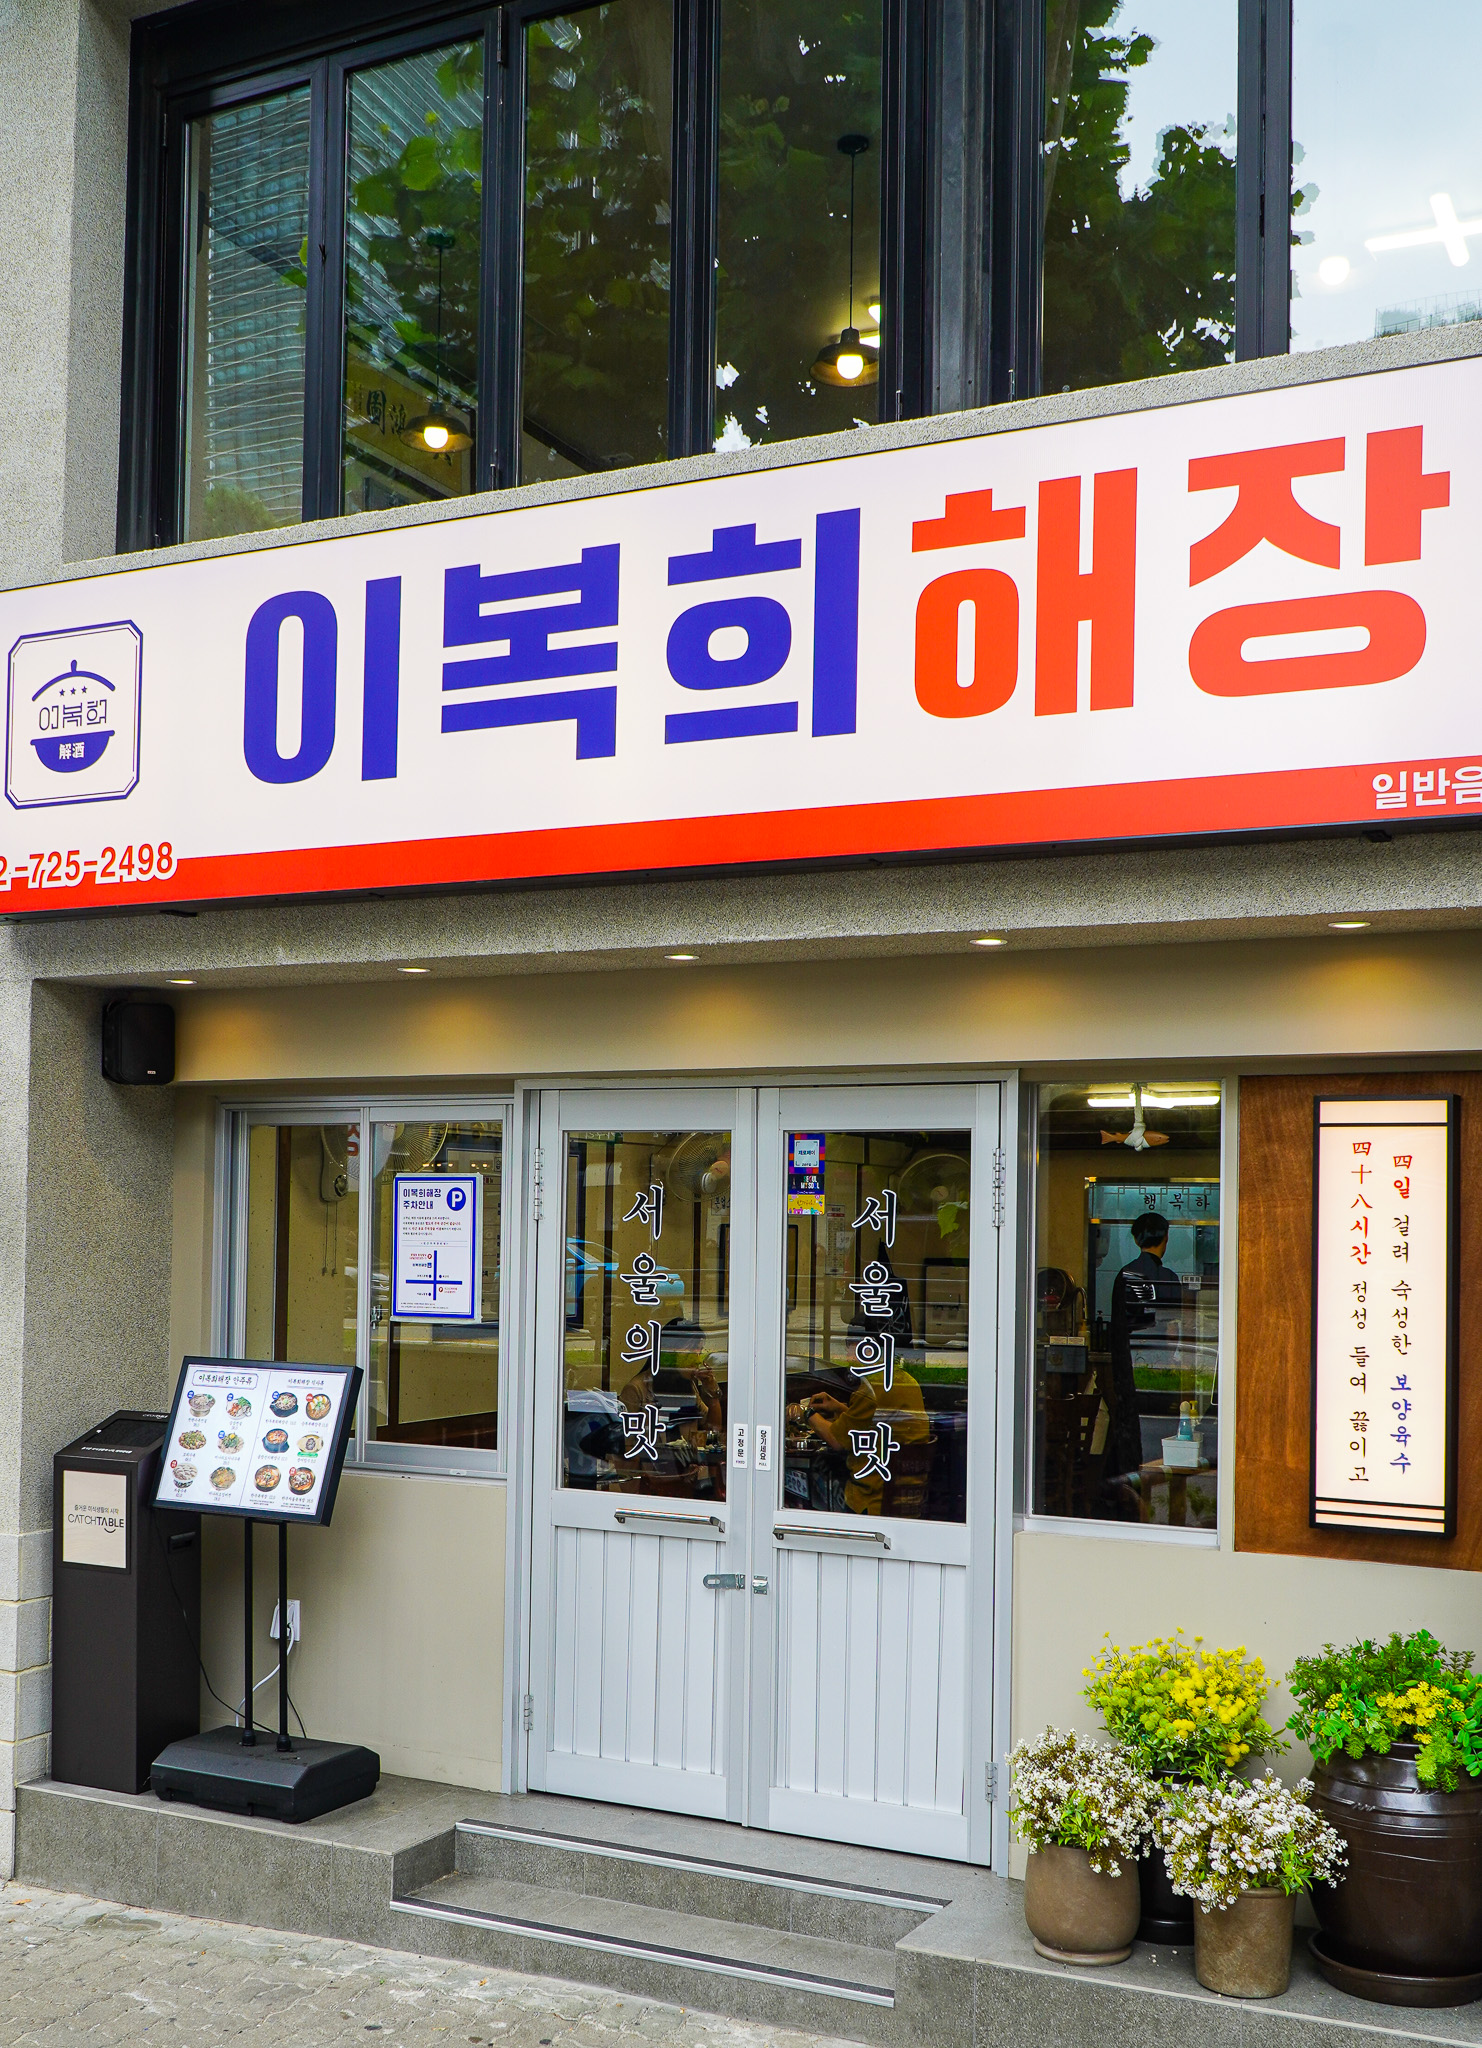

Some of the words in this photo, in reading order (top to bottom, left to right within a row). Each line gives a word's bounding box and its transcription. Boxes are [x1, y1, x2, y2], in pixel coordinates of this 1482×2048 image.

[243, 425, 1450, 785] 이복희해장
[38, 699, 108, 731] 이복희
[59, 742, 85, 760] 解酒
[402, 1188, 441, 1198] 이복희해장
[451, 1190, 463, 1208] P
[1393, 1154, 1413, 1199] 四일
[403, 1201, 434, 1210] 주차안내
[1392, 1214, 1409, 1264] 걸려
[619, 1185, 669, 1376] 서울의
[848, 1189, 903, 1392] 서울의
[1351, 1280, 1367, 1329] 정성
[1391, 1280, 1412, 1355] 숙성한
[1349, 1346, 1370, 1394] 들여
[618, 1404, 666, 1461] 맛
[737, 1428, 745, 1457] 고정문
[1348, 1411, 1370, 1481] 끓이고
[1390, 1374, 1412, 1474] 보양육수
[847, 1422, 900, 1482] 맛
[67, 1513, 125, 1528] CATCHTABLE
